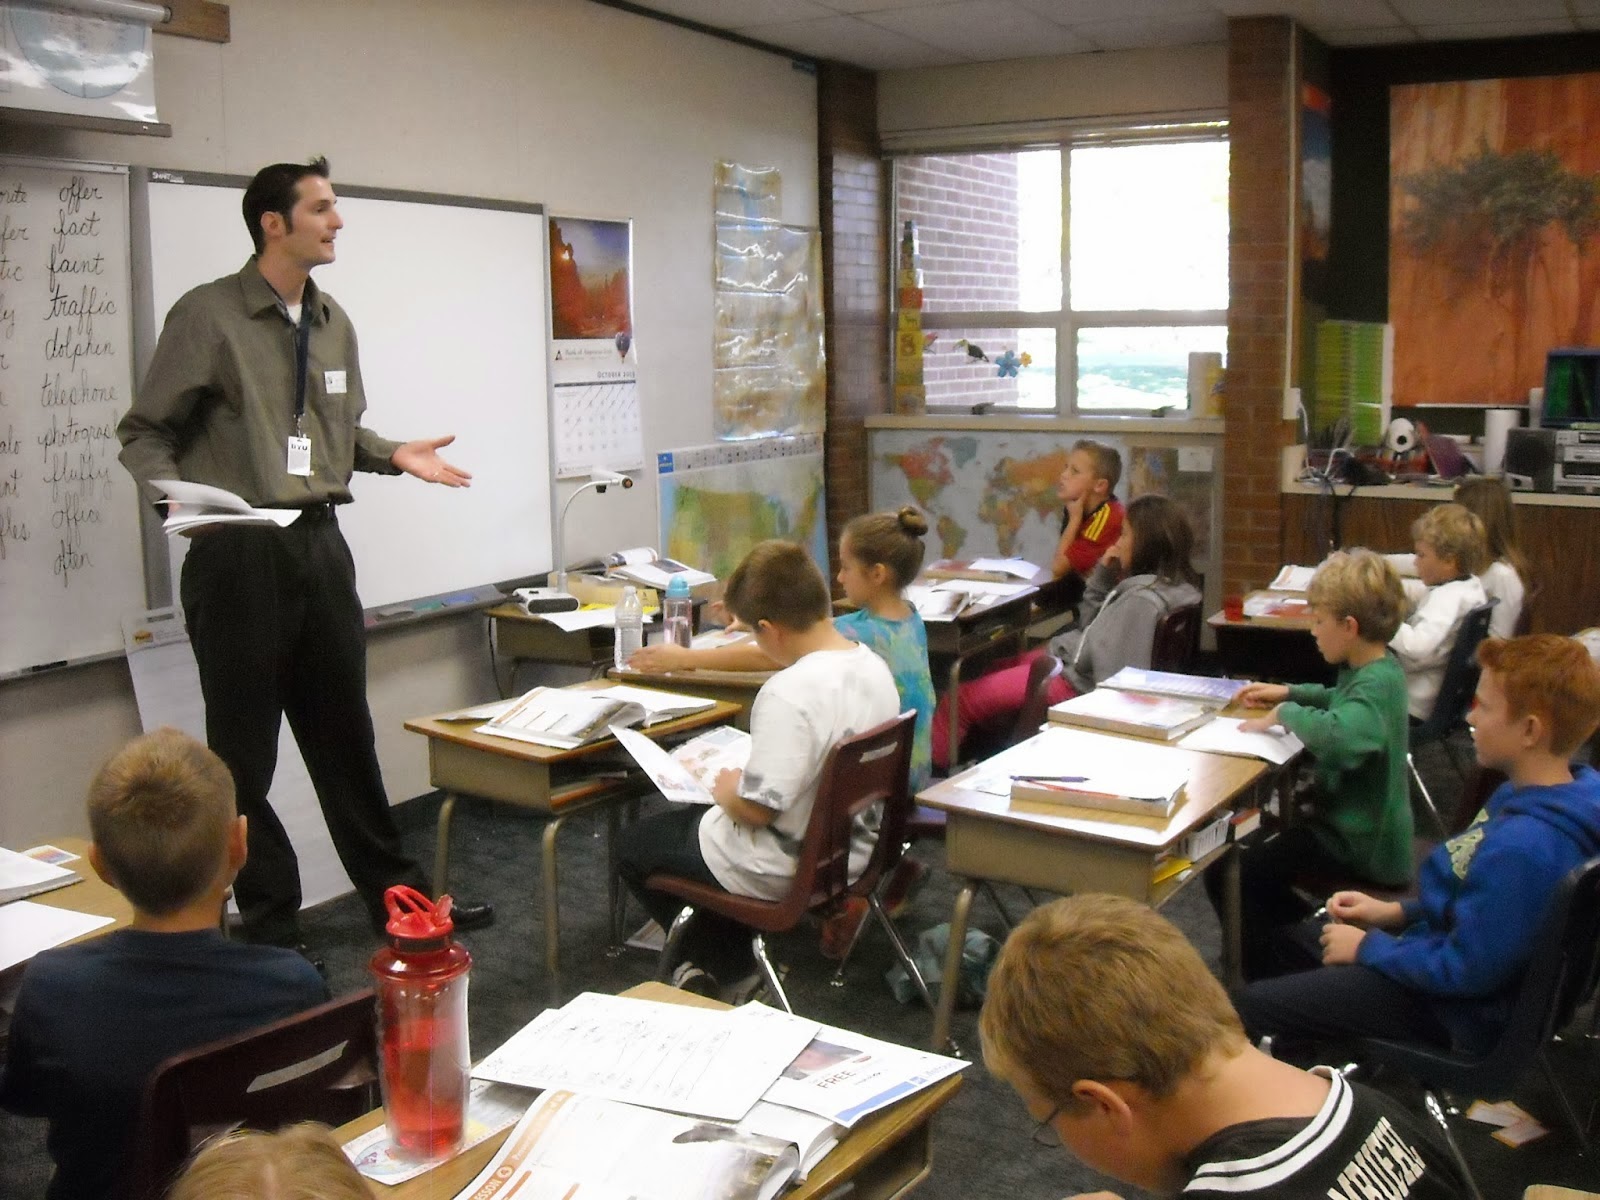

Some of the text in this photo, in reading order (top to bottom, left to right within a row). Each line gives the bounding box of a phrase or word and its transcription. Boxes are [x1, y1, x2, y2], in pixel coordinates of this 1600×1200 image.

[59, 176, 103, 214] offer
[52, 209, 100, 253] fact
[46, 245, 104, 292] faint
[43, 284, 117, 334] traffic
[45, 327, 115, 372] dolphin
[40, 369, 118, 423] telephone
[43, 451, 112, 504] fluffy
[52, 492, 101, 546] office
[53, 539, 93, 588] often
[816, 1070, 856, 1089] FREE
